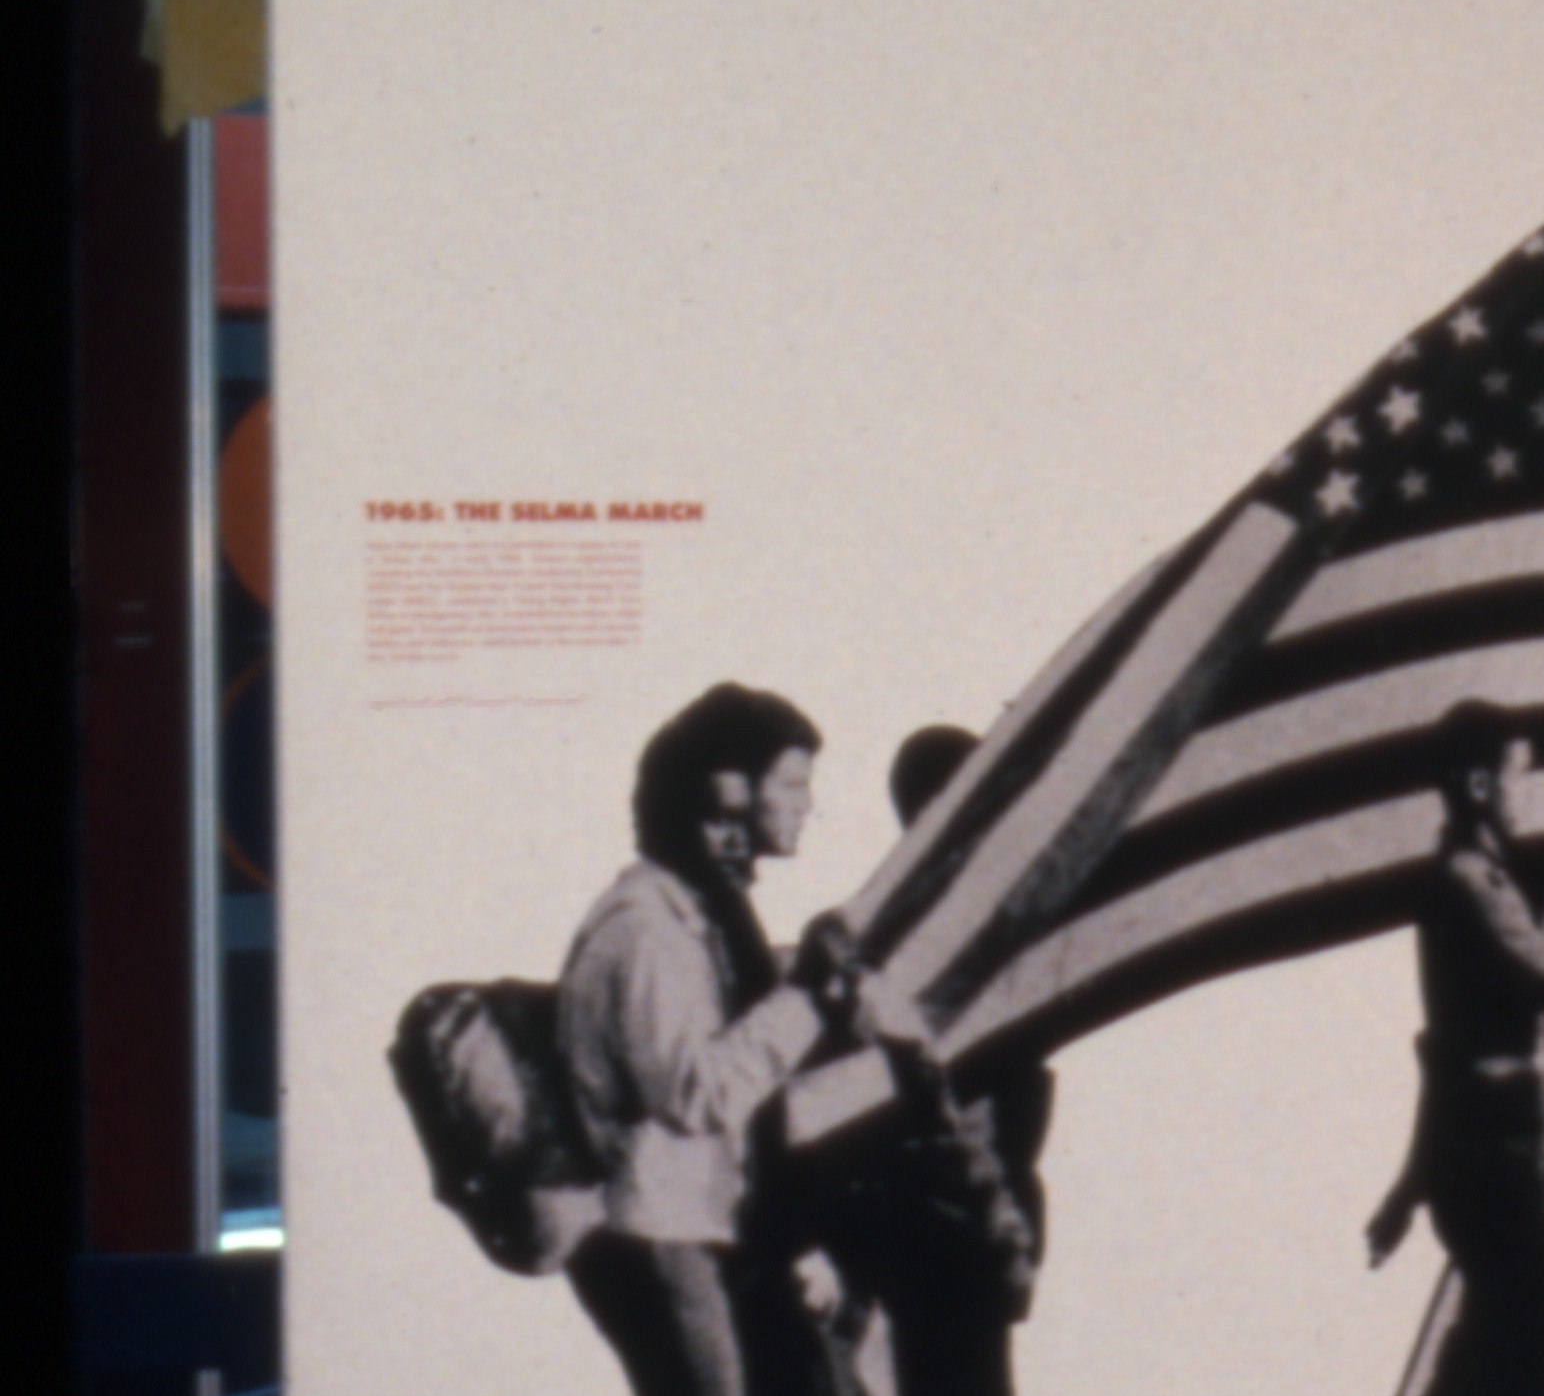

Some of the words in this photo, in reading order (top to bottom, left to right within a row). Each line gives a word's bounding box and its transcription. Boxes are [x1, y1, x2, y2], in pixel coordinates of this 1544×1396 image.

[366, 501, 444, 523] 1965:
[454, 500, 503, 522] THE
[511, 500, 598, 522] SELMA
[607, 500, 705, 522] MARCH
